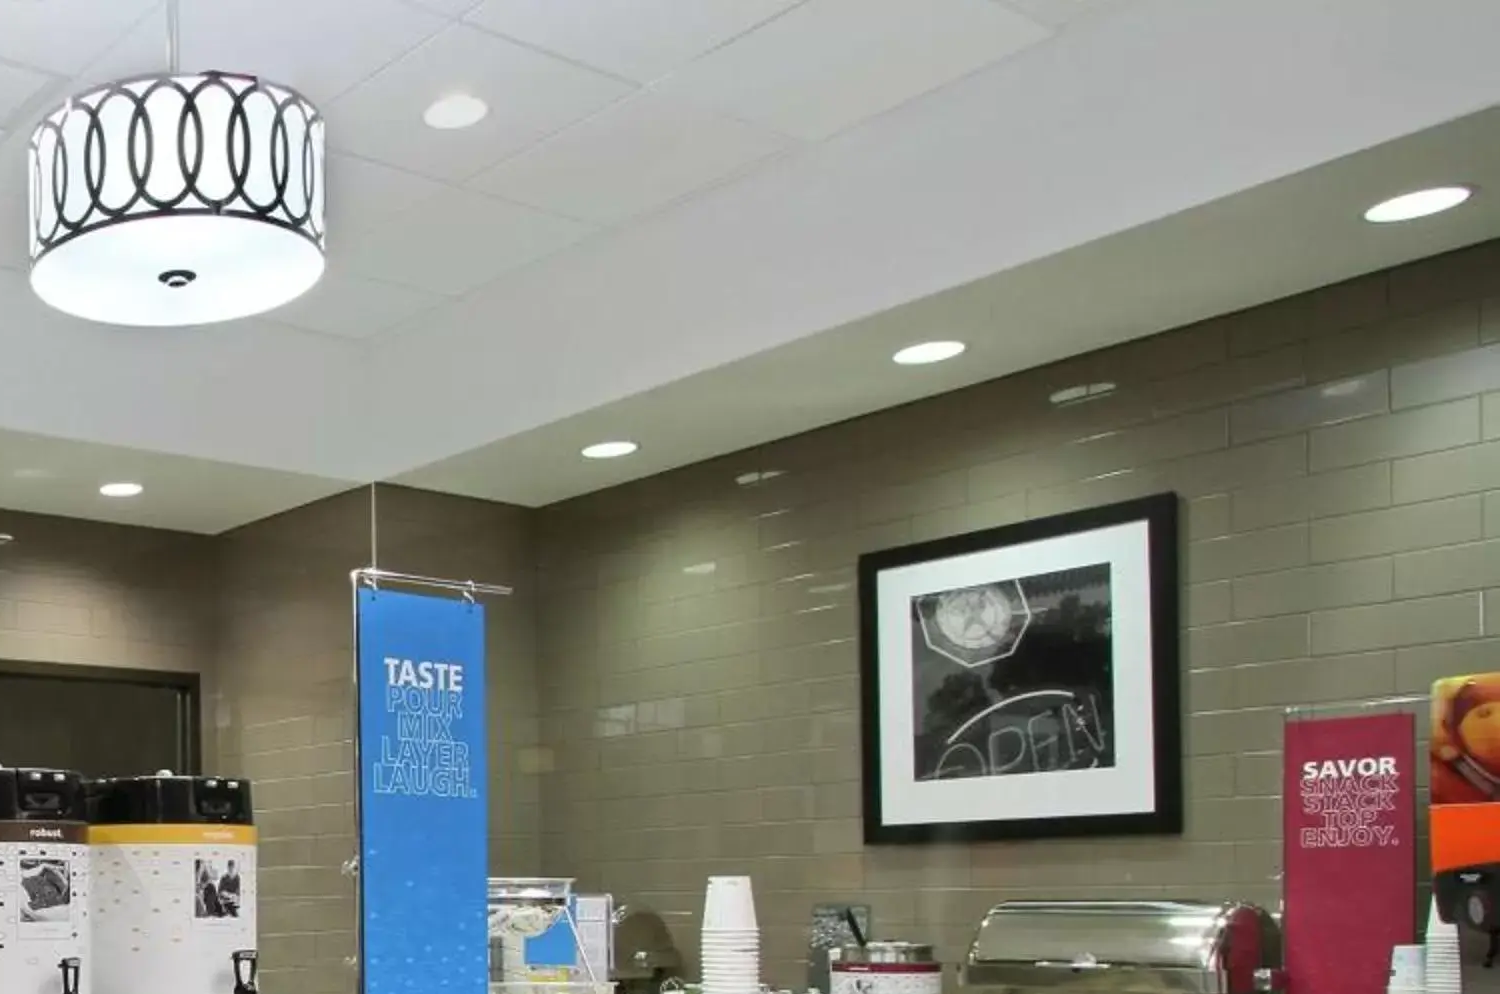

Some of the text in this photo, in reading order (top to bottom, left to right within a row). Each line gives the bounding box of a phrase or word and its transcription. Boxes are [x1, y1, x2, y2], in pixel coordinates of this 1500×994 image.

[383, 657, 464, 693] TASTE
[386, 686, 464, 720] POUR
[397, 711, 453, 744] MIX
[381, 735, 471, 772] LAYER
[373, 762, 478, 799] LAUGH.
[1303, 757, 1397, 779] SAVOR
[1300, 772, 1400, 796] SNACK
[1302, 791, 1397, 815] STACK
[1321, 808, 1378, 831] TOP
[1299, 825, 1400, 848] ENJOY.
